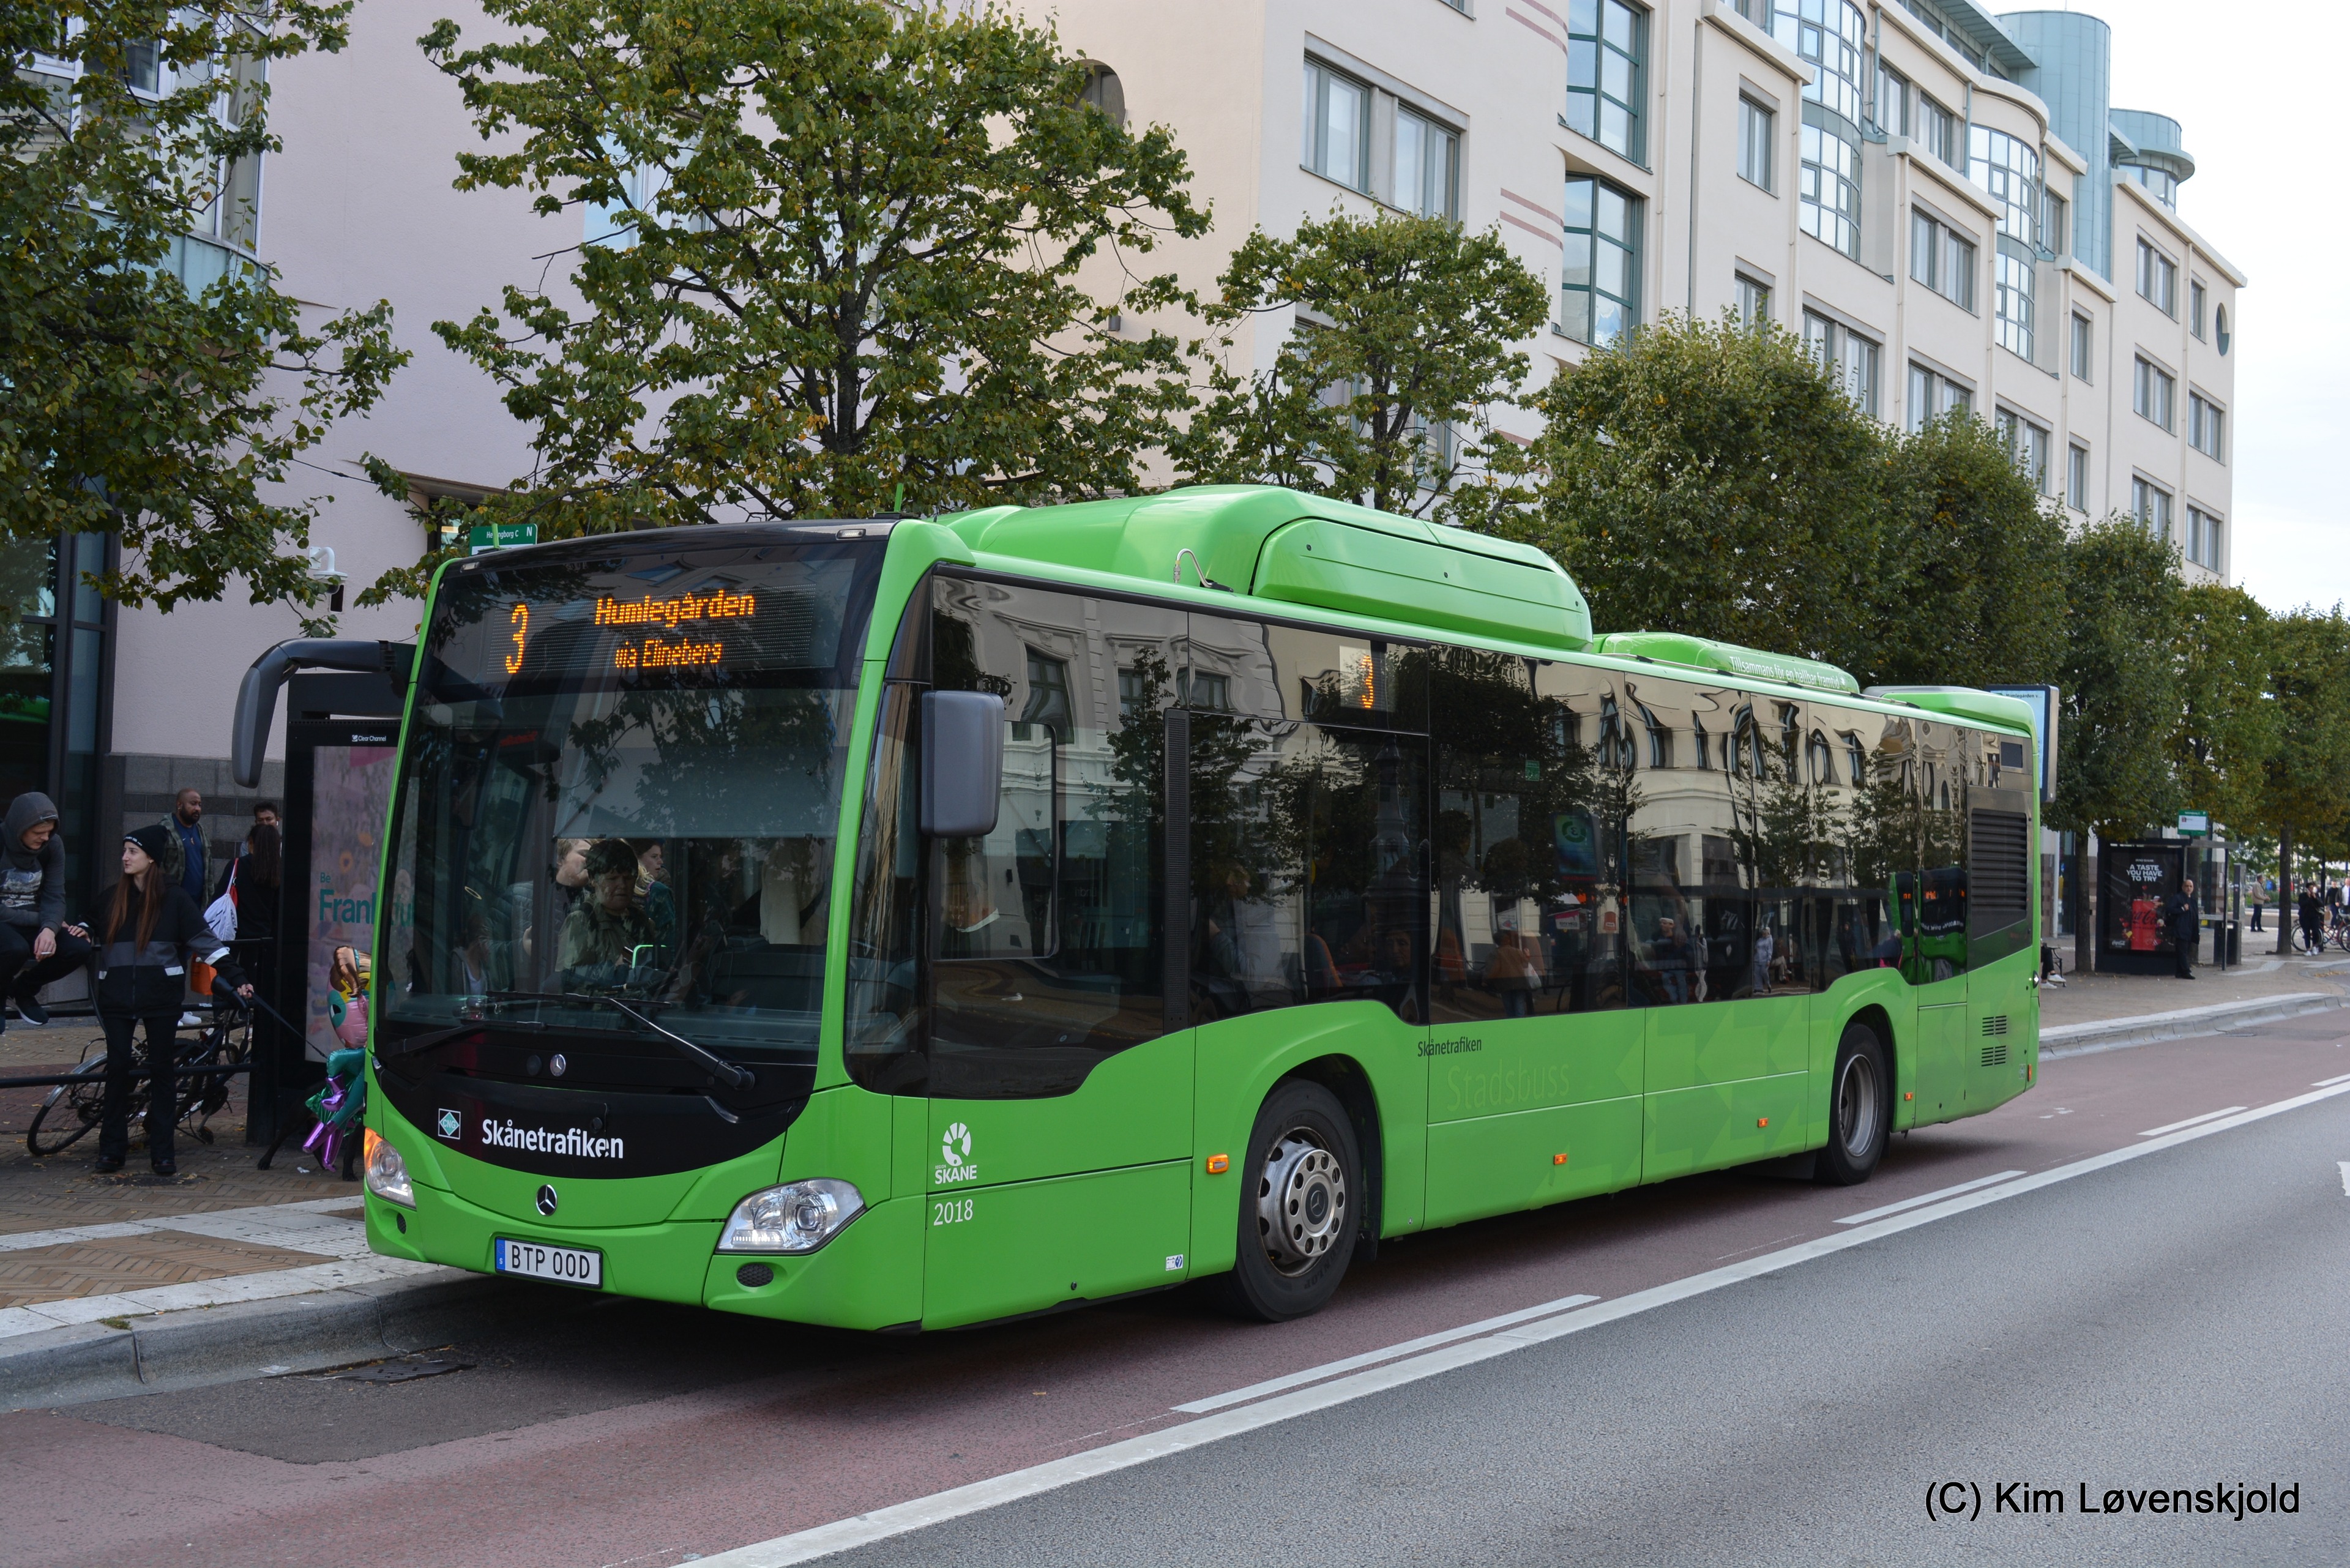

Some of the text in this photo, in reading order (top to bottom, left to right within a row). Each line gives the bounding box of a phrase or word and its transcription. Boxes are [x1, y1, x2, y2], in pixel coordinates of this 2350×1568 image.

[487, 530, 514, 539] Hengborg
[526, 526, 532, 536] N
[595, 589, 756, 628] Humlegården
[505, 603, 529, 673] 3
[615, 638, 722, 668] via Elineberg
[1361, 655, 1373, 708] 3
[1729, 656, 1840, 689] Tillsammans för en hållbar framtid
[320, 872, 331, 883] Be
[1417, 1036, 1482, 1058] Skånetrafiken
[1447, 1057, 1570, 1112] Stadsbuss
[442, 1119, 456, 1129] CNG
[482, 1119, 624, 1159] Skånetrafiken
[933, 1199, 973, 1226] 2018
[512, 1244, 545, 1272] BTP
